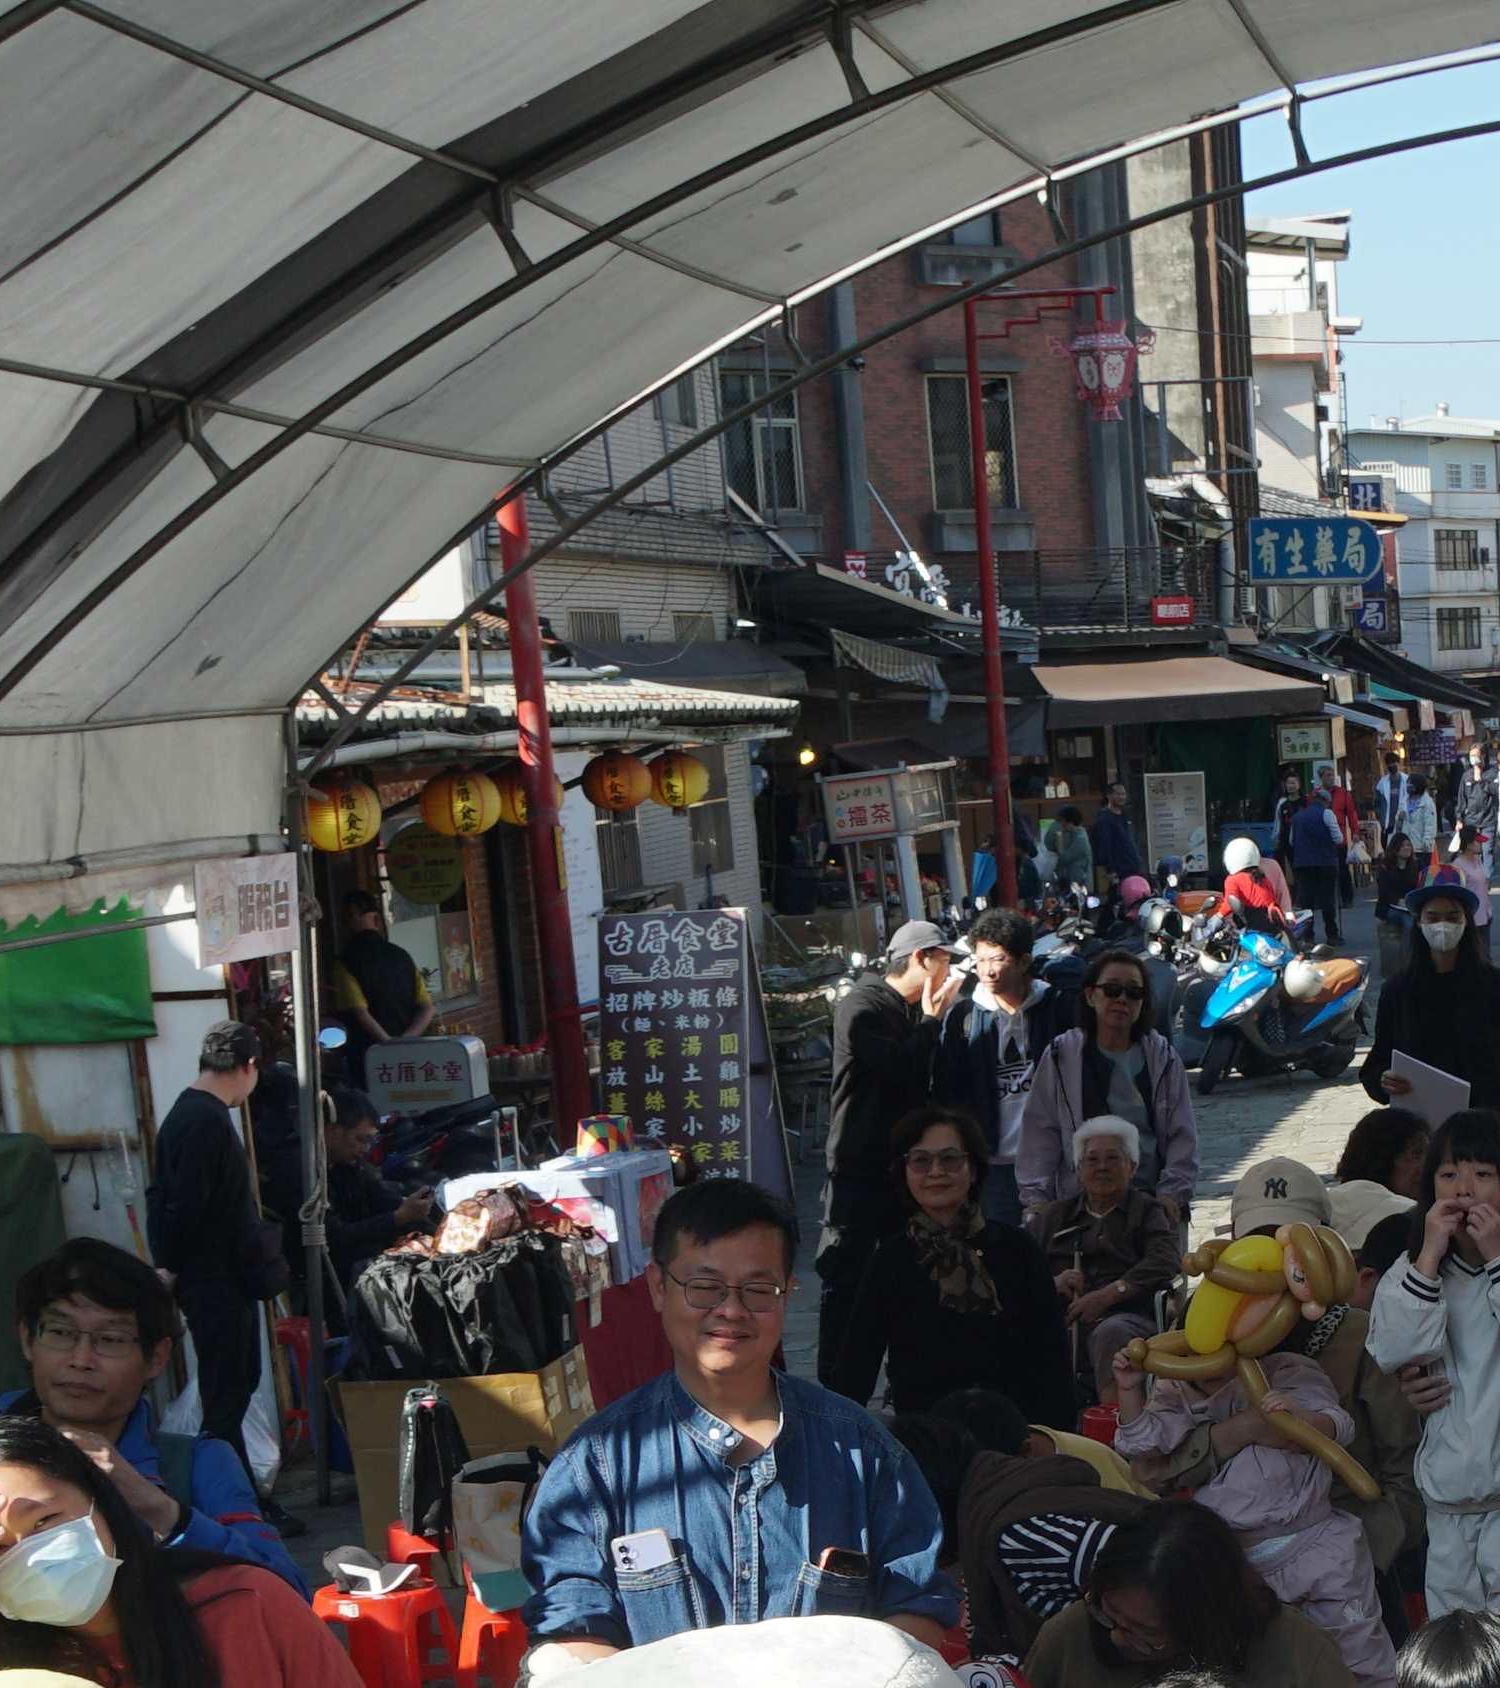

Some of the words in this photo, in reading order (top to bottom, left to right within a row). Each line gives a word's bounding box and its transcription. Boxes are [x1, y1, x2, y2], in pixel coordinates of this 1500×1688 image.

[1255, 525, 1366, 577] 有生藥局
[848, 803, 892, 828] 擂茶
[238, 880, 290, 935] 服務台
[604, 917, 740, 956] 古厝食堂
[650, 955, 696, 979] 老店
[606, 1033, 740, 1061] 客家湯圓
[607, 1060, 741, 1087] 放山土雞
[607, 1087, 741, 1115] 薑絲大腸
[644, 1113, 741, 1139] 家小炒
[1264, 1177, 1288, 1199] NY
